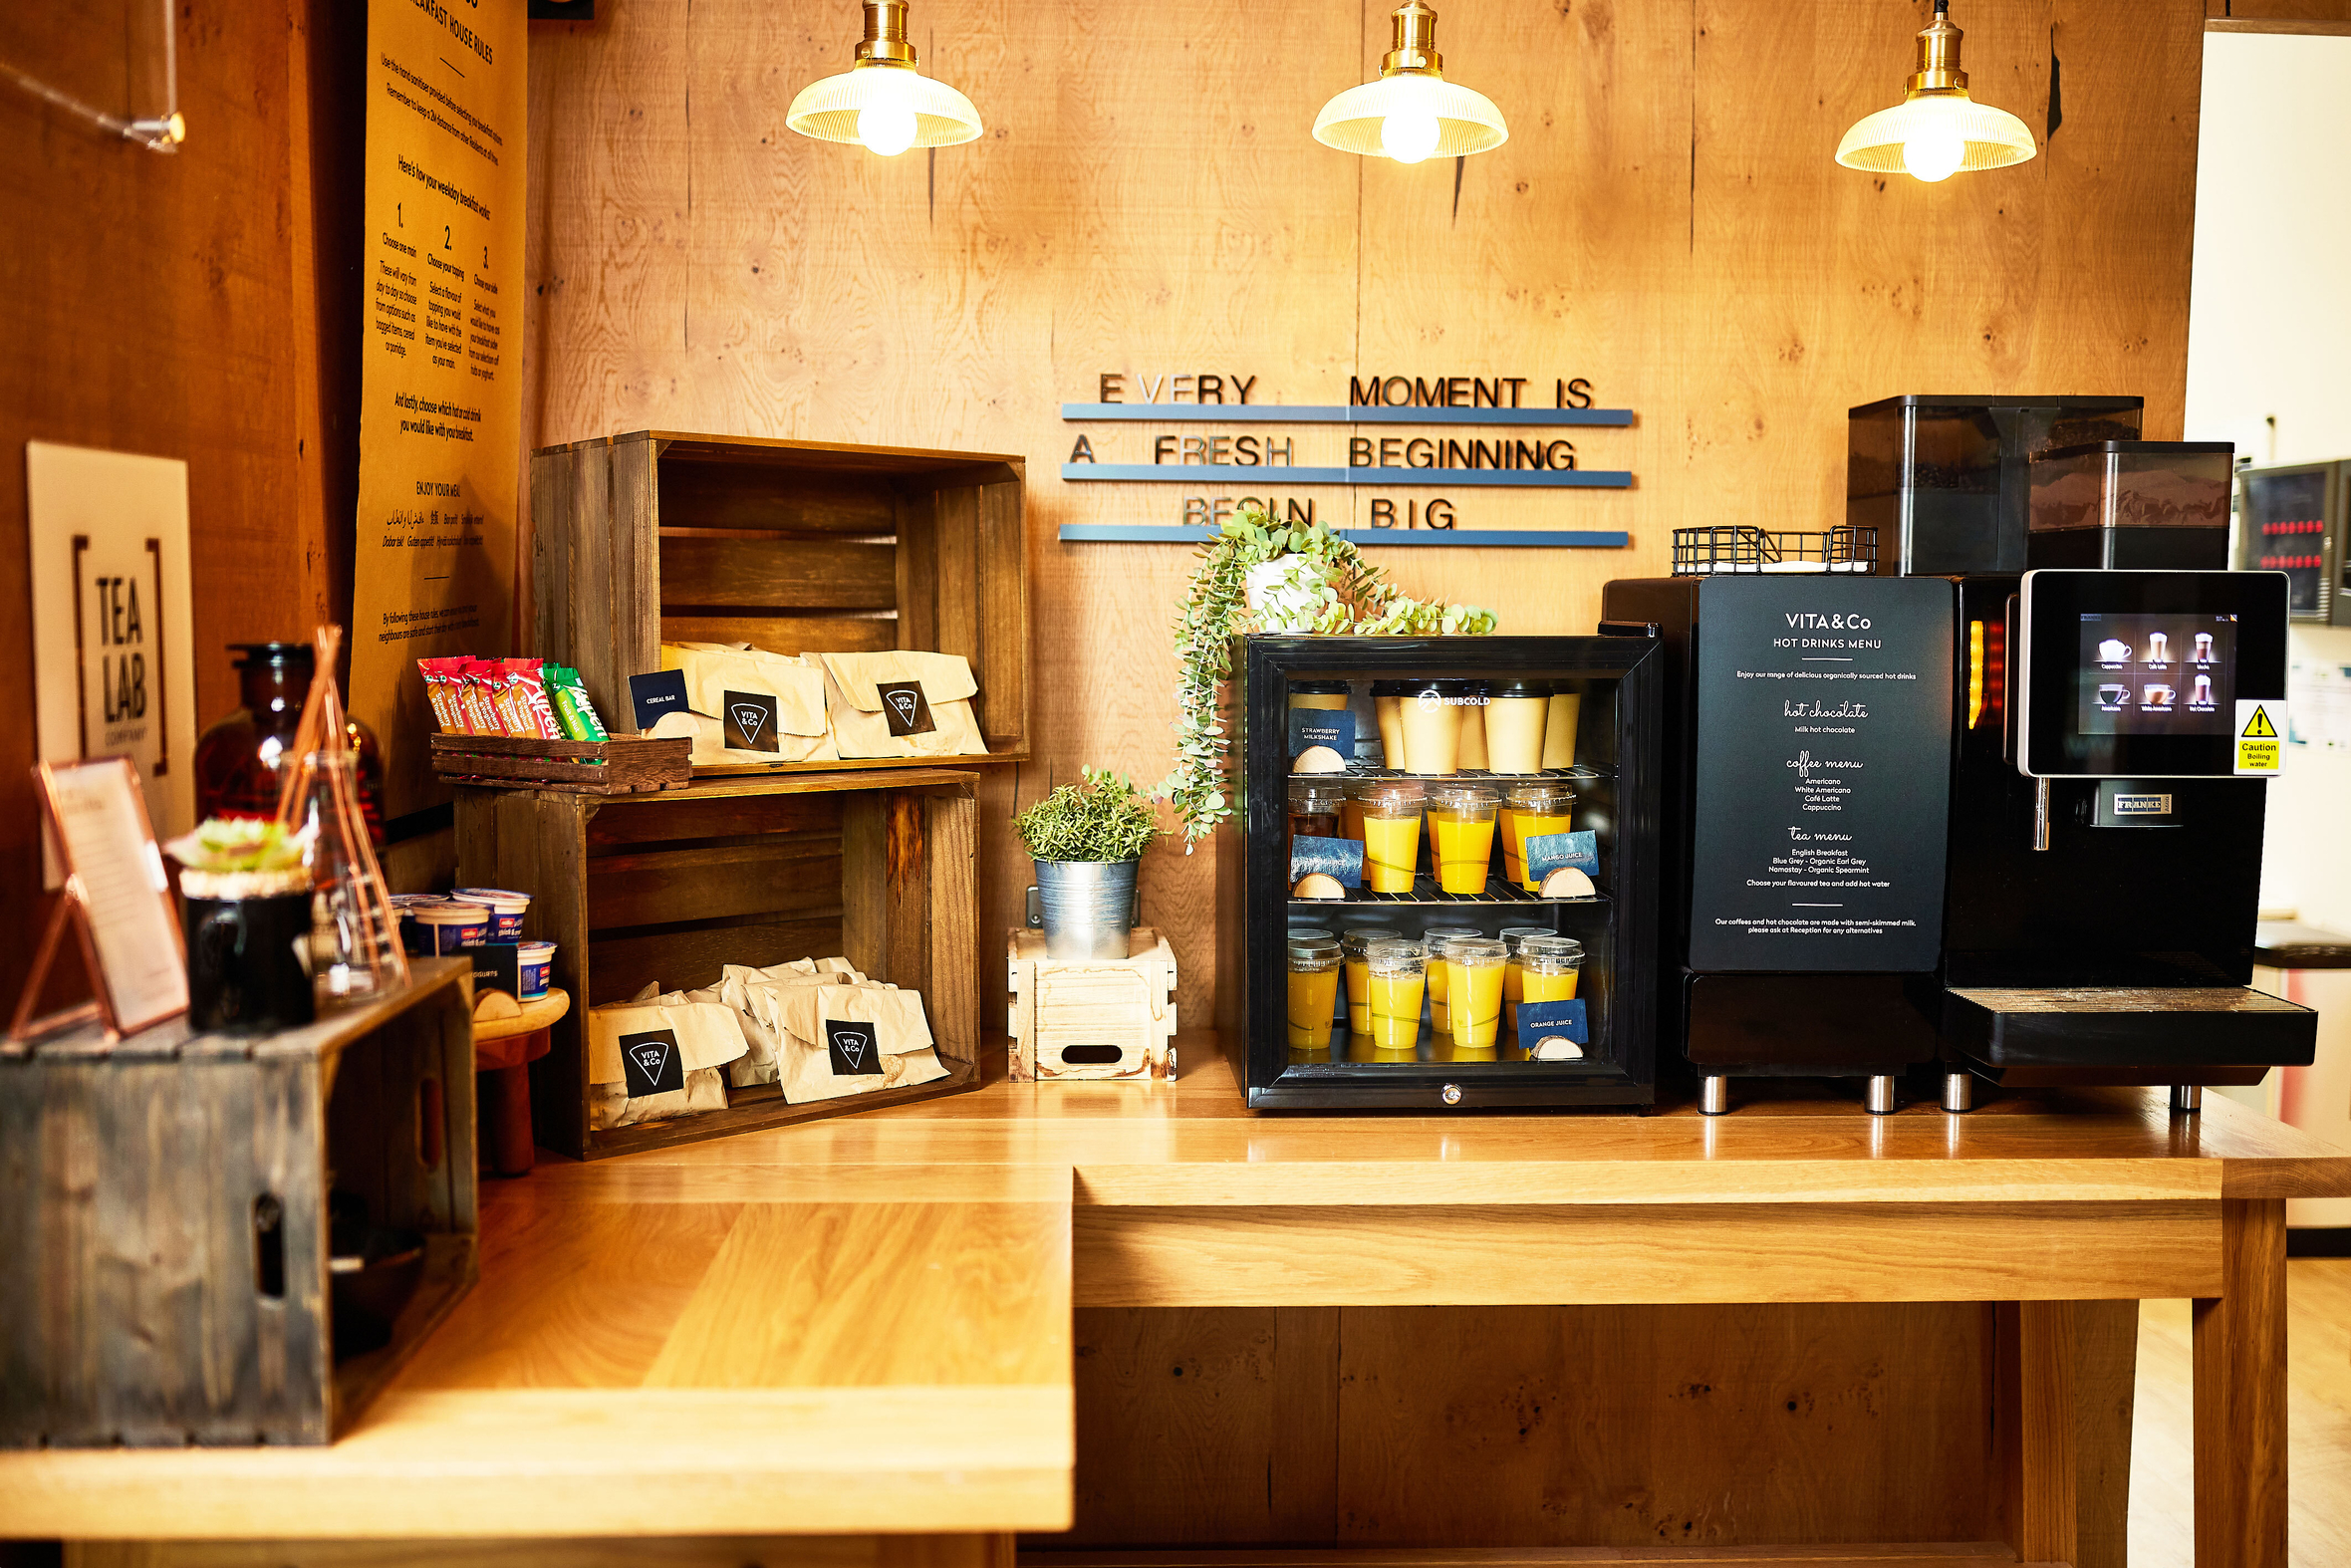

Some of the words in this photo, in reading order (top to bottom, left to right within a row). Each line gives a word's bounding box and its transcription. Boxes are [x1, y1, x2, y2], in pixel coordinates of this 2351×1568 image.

[450, 15, 472, 48] HOUSE
[474, 35, 492, 65] RULES
[398, 154, 415, 177] Here's
[416, 163, 425, 182] how
[426, 174, 437, 189] your
[438, 181, 459, 206] weekday
[460, 188, 478, 213] breakfast
[397, 202, 403, 228] 1.
[383, 232, 398, 250] Choose
[444, 225, 452, 251] 2.
[427, 253, 443, 269] Choose
[1100, 374, 1256, 404] EVERY
[1350, 376, 1527, 408] MOMENT
[1557, 378, 1592, 409] IS
[394, 392, 404, 407] And
[419, 396, 437, 414] choose
[438, 400, 451, 416] which
[400, 419, 409, 434] you
[410, 418, 425, 434] would
[425, 419, 434, 435] like
[435, 422, 445, 437] with
[1069, 434, 1095, 464] A
[1156, 435, 1292, 466] FRESH
[1349, 437, 1574, 471] BEGINNING
[417, 481, 434, 496] ENJOY
[434, 482, 449, 497] YOUR
[1371, 499, 1454, 529] BIG
[95, 576, 144, 646] TEA
[1774, 638, 1798, 648] HOT
[1802, 638, 1844, 648] DRINKS
[1848, 639, 1881, 649] MENU
[102, 653, 146, 723] LAB
[436, 693, 451, 726] Strawberry
[470, 695, 486, 729] Strawberry
[521, 695, 536, 730] Strawberry
[563, 684, 608, 739] Alpen
[646, 696, 664, 705] CEREAL
[898, 702, 913, 711] &Co
[1444, 696, 1491, 706] SUBCOLD
[1784, 700, 1809, 717] hot
[1809, 700, 1868, 718] chocolate
[434, 702, 445, 727] Yoghurt
[468, 704, 480, 730] Yoghurt
[481, 706, 495, 732] Yoghurt
[483, 696, 501, 730] Strawberry
[504, 698, 521, 732] Strawberry
[519, 705, 530, 731] Yoghurt
[561, 700, 571, 715] Fruit
[571, 720, 580, 733] Nut
[741, 710, 759, 719] VITA
[741, 718, 758, 727] &Co
[105, 729, 146, 747] COMPANY
[1301, 727, 1340, 735] STRAWBERRY
[2242, 743, 2276, 751] Caution
[1786, 750, 1822, 777] coffee
[1788, 826, 1811, 840] tea
[1792, 849, 1815, 857] English
[1810, 857, 1835, 866] Organic
[1530, 1020, 1555, 1029] ORANGE
[641, 1049, 660, 1059] VITA
[842, 1038, 859, 1046] VITA
[643, 1057, 661, 1067] &Co
